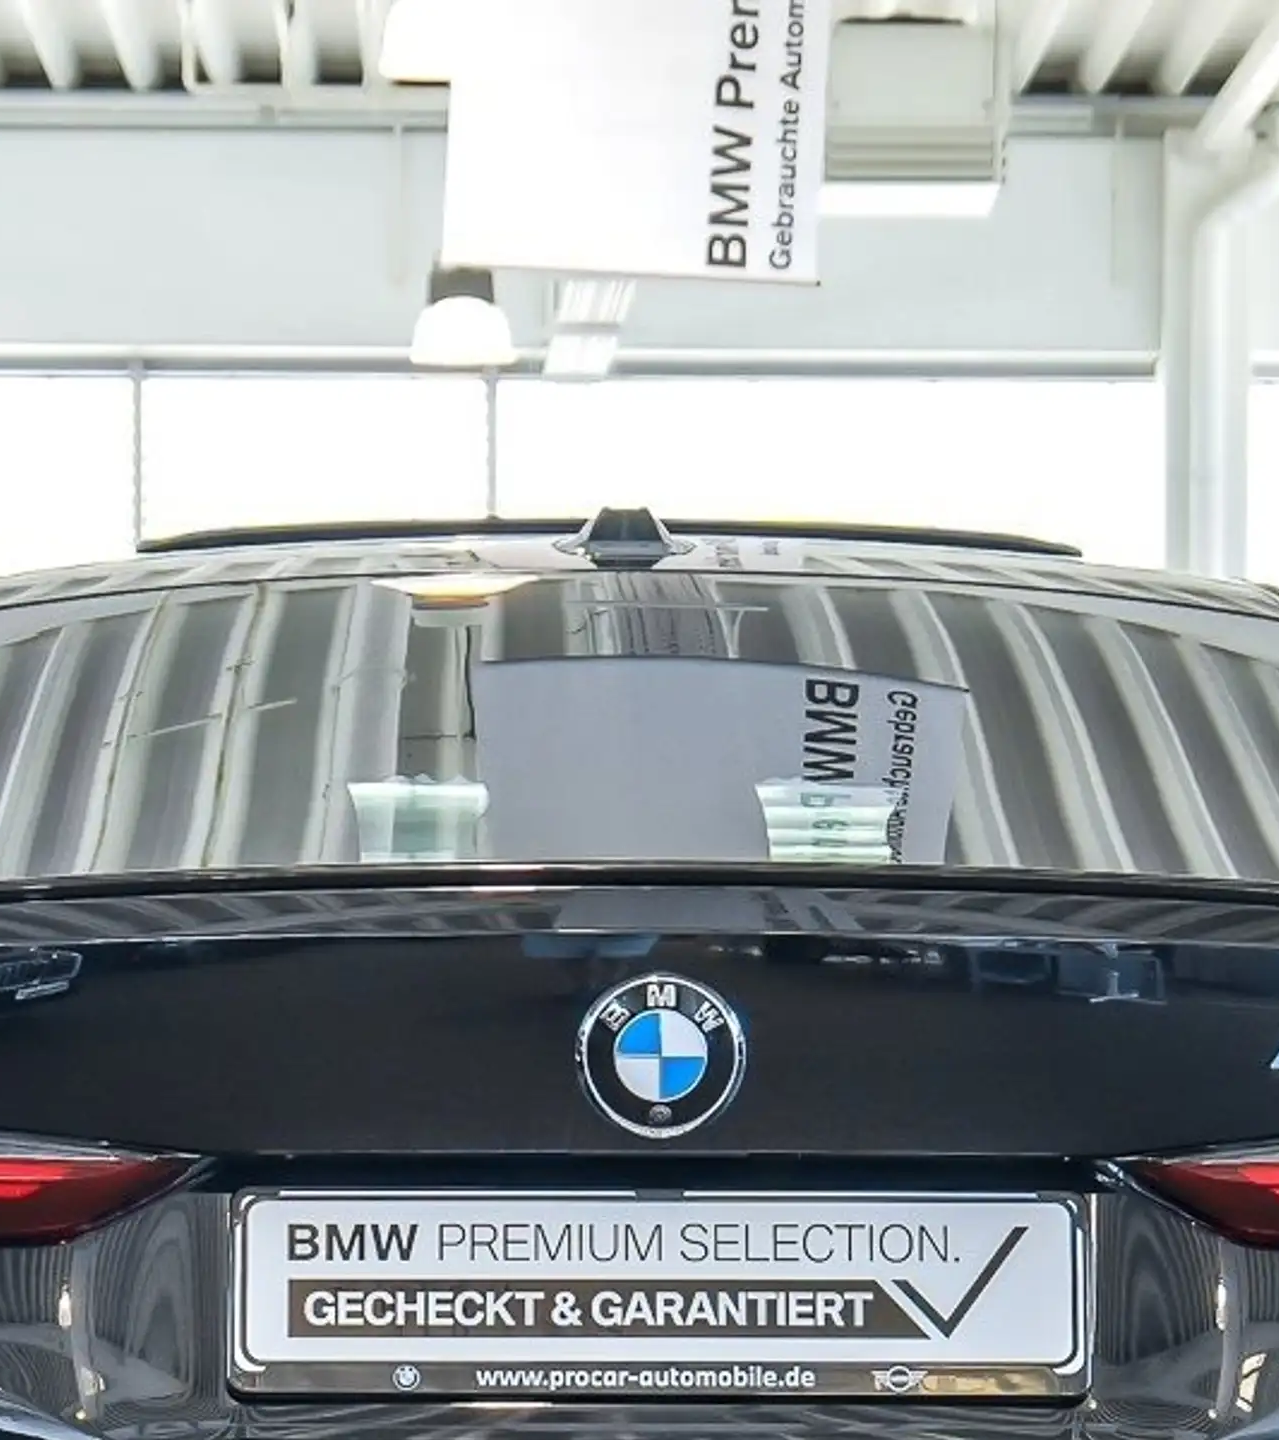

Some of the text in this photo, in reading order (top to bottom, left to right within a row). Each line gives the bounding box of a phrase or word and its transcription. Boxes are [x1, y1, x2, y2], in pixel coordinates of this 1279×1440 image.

[706, 123, 753, 268] BMW
[768, 99, 801, 270] Gebrauchte
[599, 984, 724, 1032] BMW
[287, 1222, 961, 1263] BMW PREMIUM SELECTION.
[304, 1291, 875, 1327] GECHECKT & GARANTIERT
[475, 1365, 817, 1391] www.procar-automobile.de
